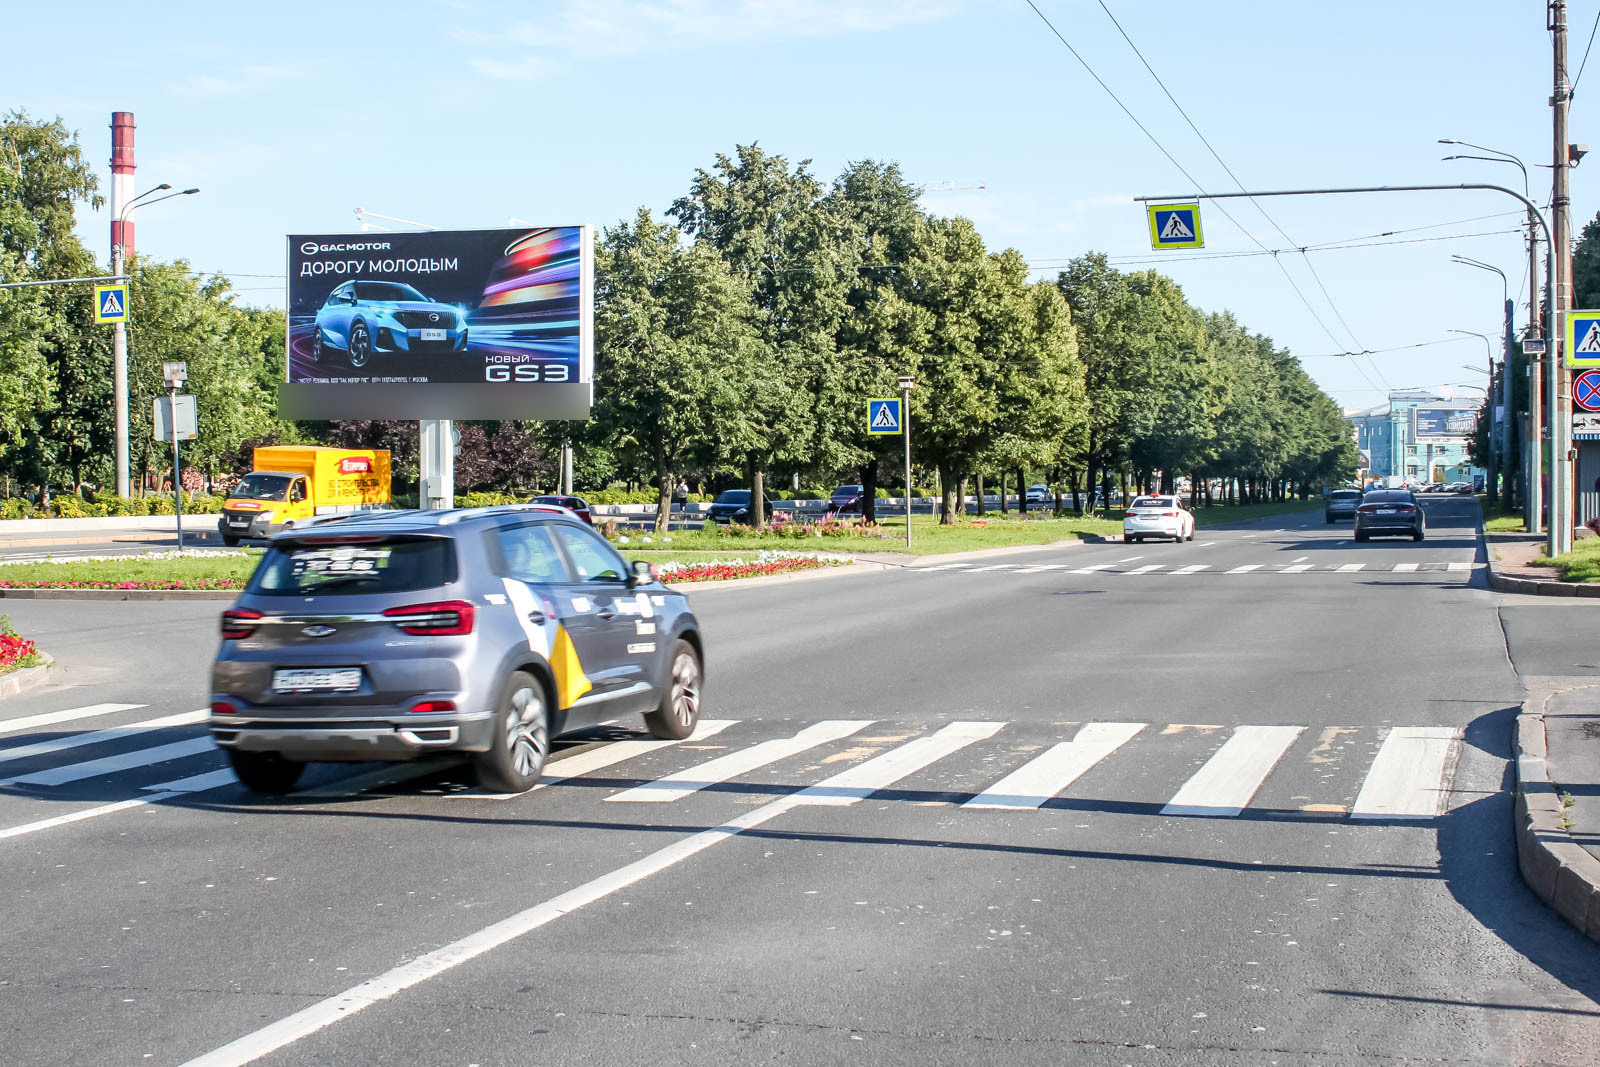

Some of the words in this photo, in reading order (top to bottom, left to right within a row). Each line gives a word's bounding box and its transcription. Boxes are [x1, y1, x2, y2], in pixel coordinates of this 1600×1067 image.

[300, 260, 365, 277] ДОРОГУ
[369, 257, 458, 274] МОЛОДЫМ
[485, 354, 530, 363] НОВЫЙ
[485, 364, 569, 382] GS3
